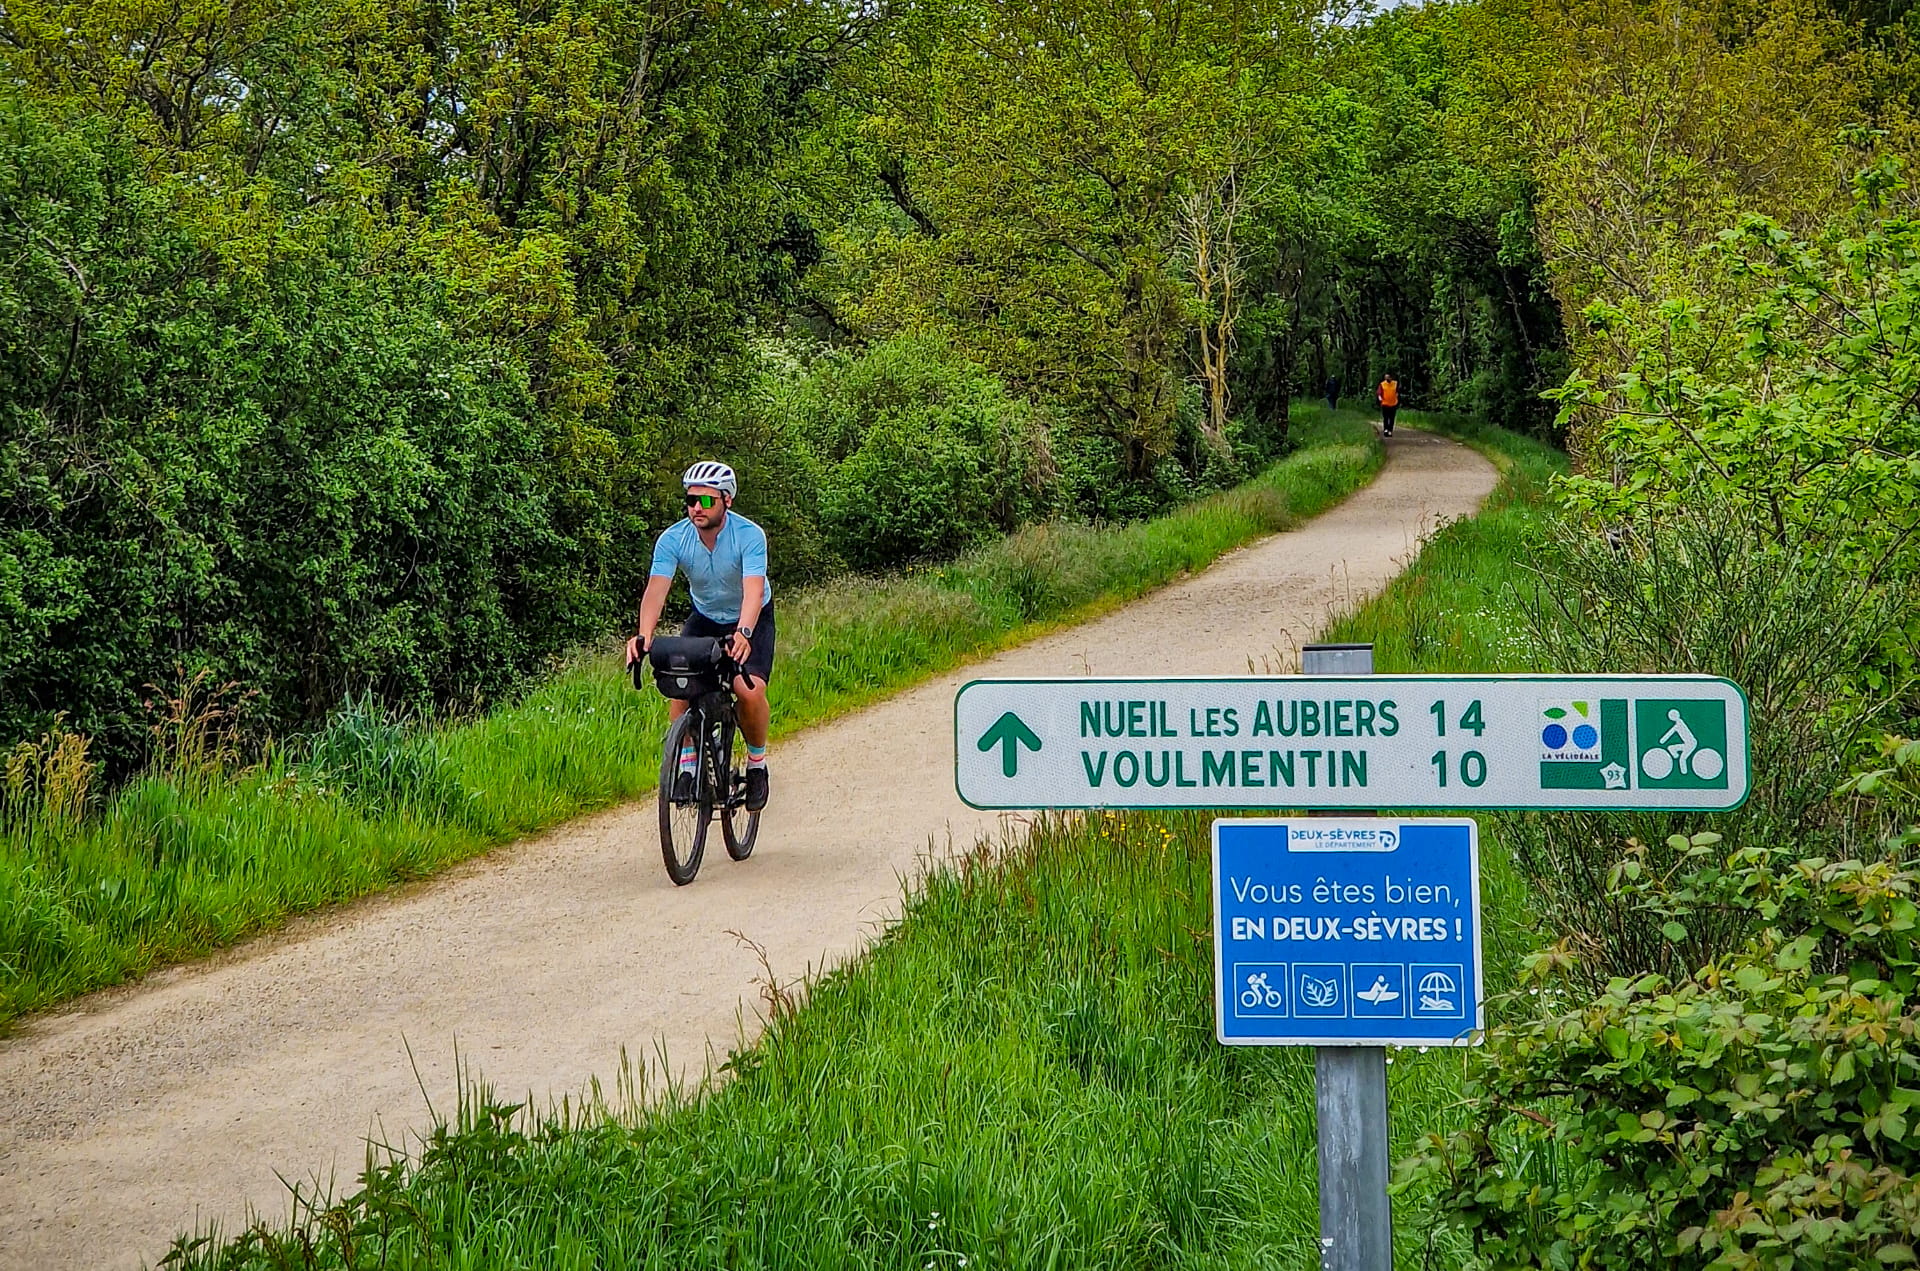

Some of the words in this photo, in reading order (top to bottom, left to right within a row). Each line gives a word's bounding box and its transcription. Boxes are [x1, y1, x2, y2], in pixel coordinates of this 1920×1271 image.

[1080, 701, 1177, 737] NUEIL
[1190, 708, 1239, 737] LES
[1252, 700, 1399, 737] AUBIERS
[1430, 700, 1485, 736] 14
[1081, 750, 1368, 787] VOULMENTIN
[1431, 750, 1487, 787] 10
[1607, 770, 1620, 781] 93
[1291, 829, 1376, 840] DEUX-SÈVRES
[1315, 841, 1323, 849] LE
[1325, 840, 1376, 849] DÉPARTEMENT
[1230, 876, 1302, 903] Vous
[1312, 876, 1375, 903] êtes
[1385, 875, 1460, 908] bien,
[1232, 917, 1265, 940] EN
[1273, 910, 1448, 940] DEUX-SÈVRES
[1455, 918, 1463, 941] !
